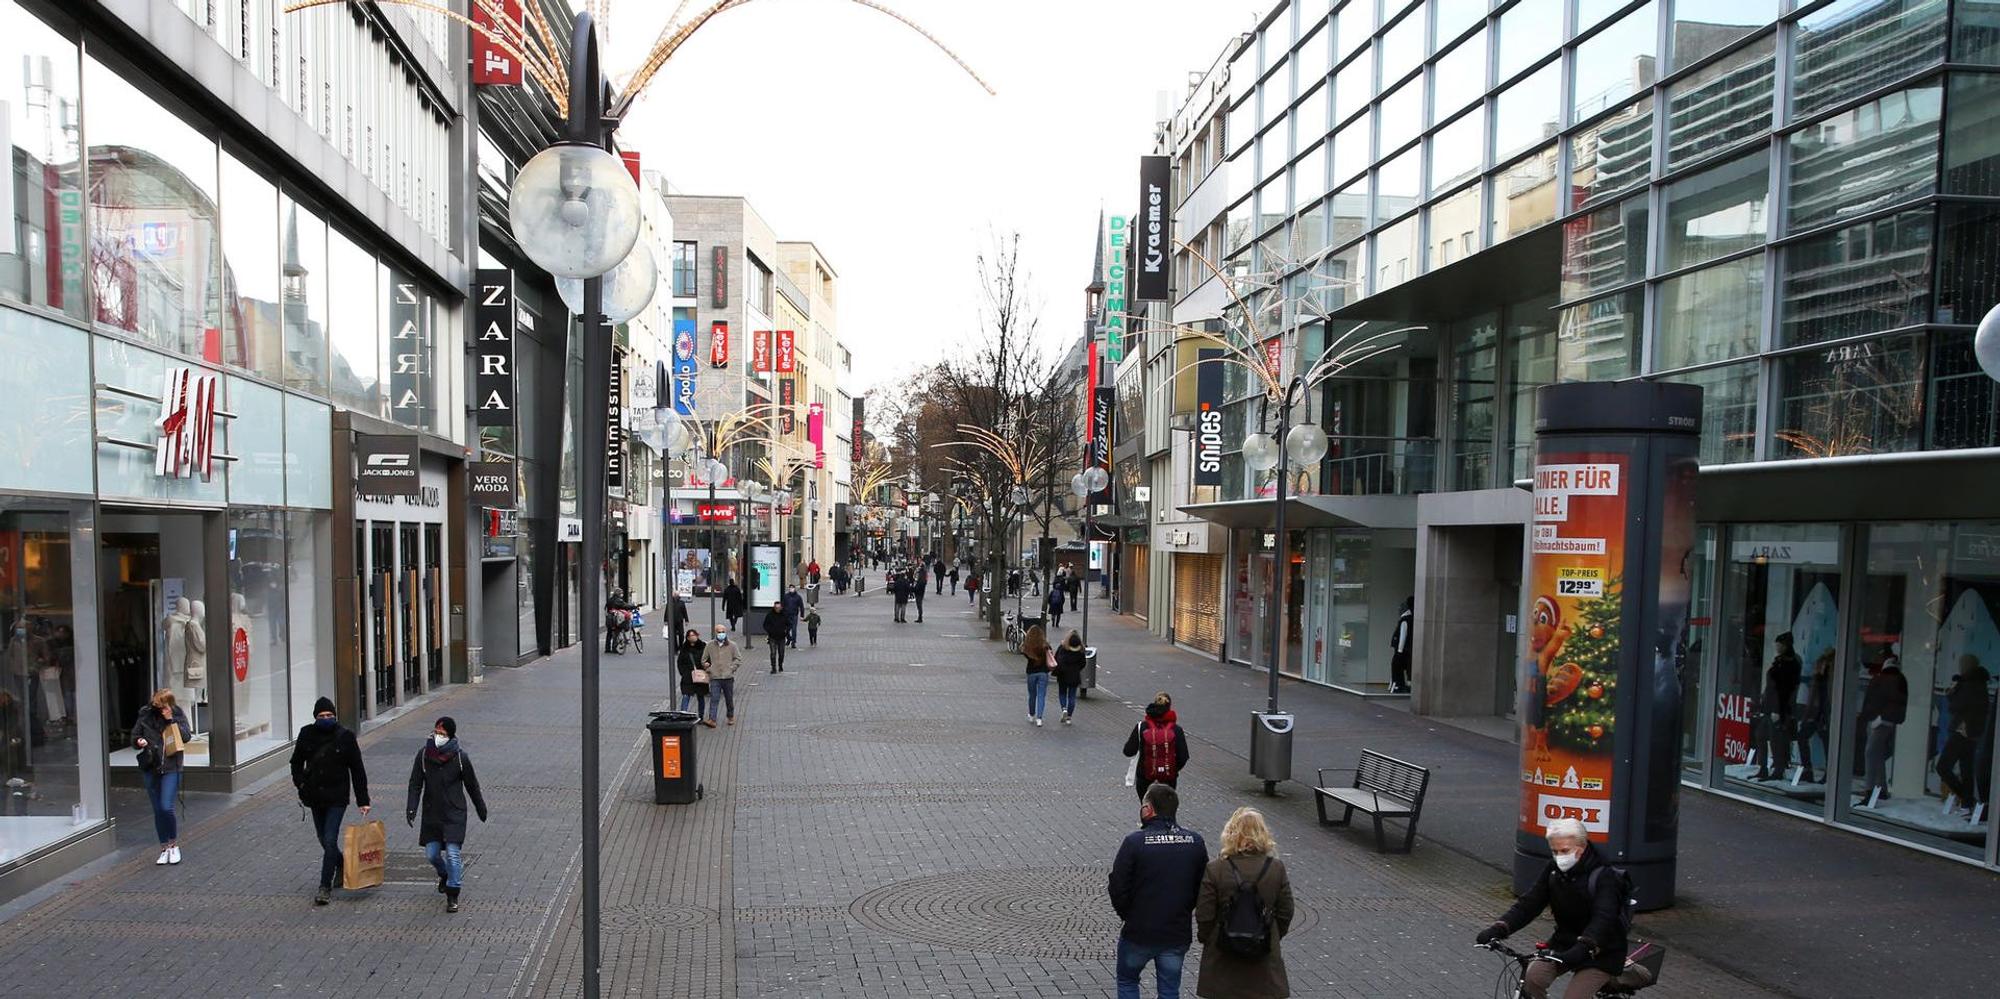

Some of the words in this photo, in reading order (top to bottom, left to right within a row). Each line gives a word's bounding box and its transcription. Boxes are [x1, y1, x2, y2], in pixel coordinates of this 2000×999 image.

[1145, 184, 1163, 273] Kraemer
[1107, 216, 1126, 361] DEICHMANN
[481, 285, 509, 409] ZARA
[155, 367, 216, 484] H&M
[1094, 396, 1108, 426] Hut
[1097, 427, 1109, 464] Pizza
[1200, 411, 1223, 473] snipes
[473, 484, 510, 493] MODA
[475, 475, 508, 484] VERO
[1536, 470, 1569, 490] EINER
[1574, 466, 1611, 489] FÜR
[1535, 497, 1563, 515] ALLE.
[1561, 569, 1599, 578] TOP-PREIS
[1717, 693, 1752, 723] SALE
[1724, 739, 1748, 761] 50%
[1544, 804, 1601, 823] OBI
